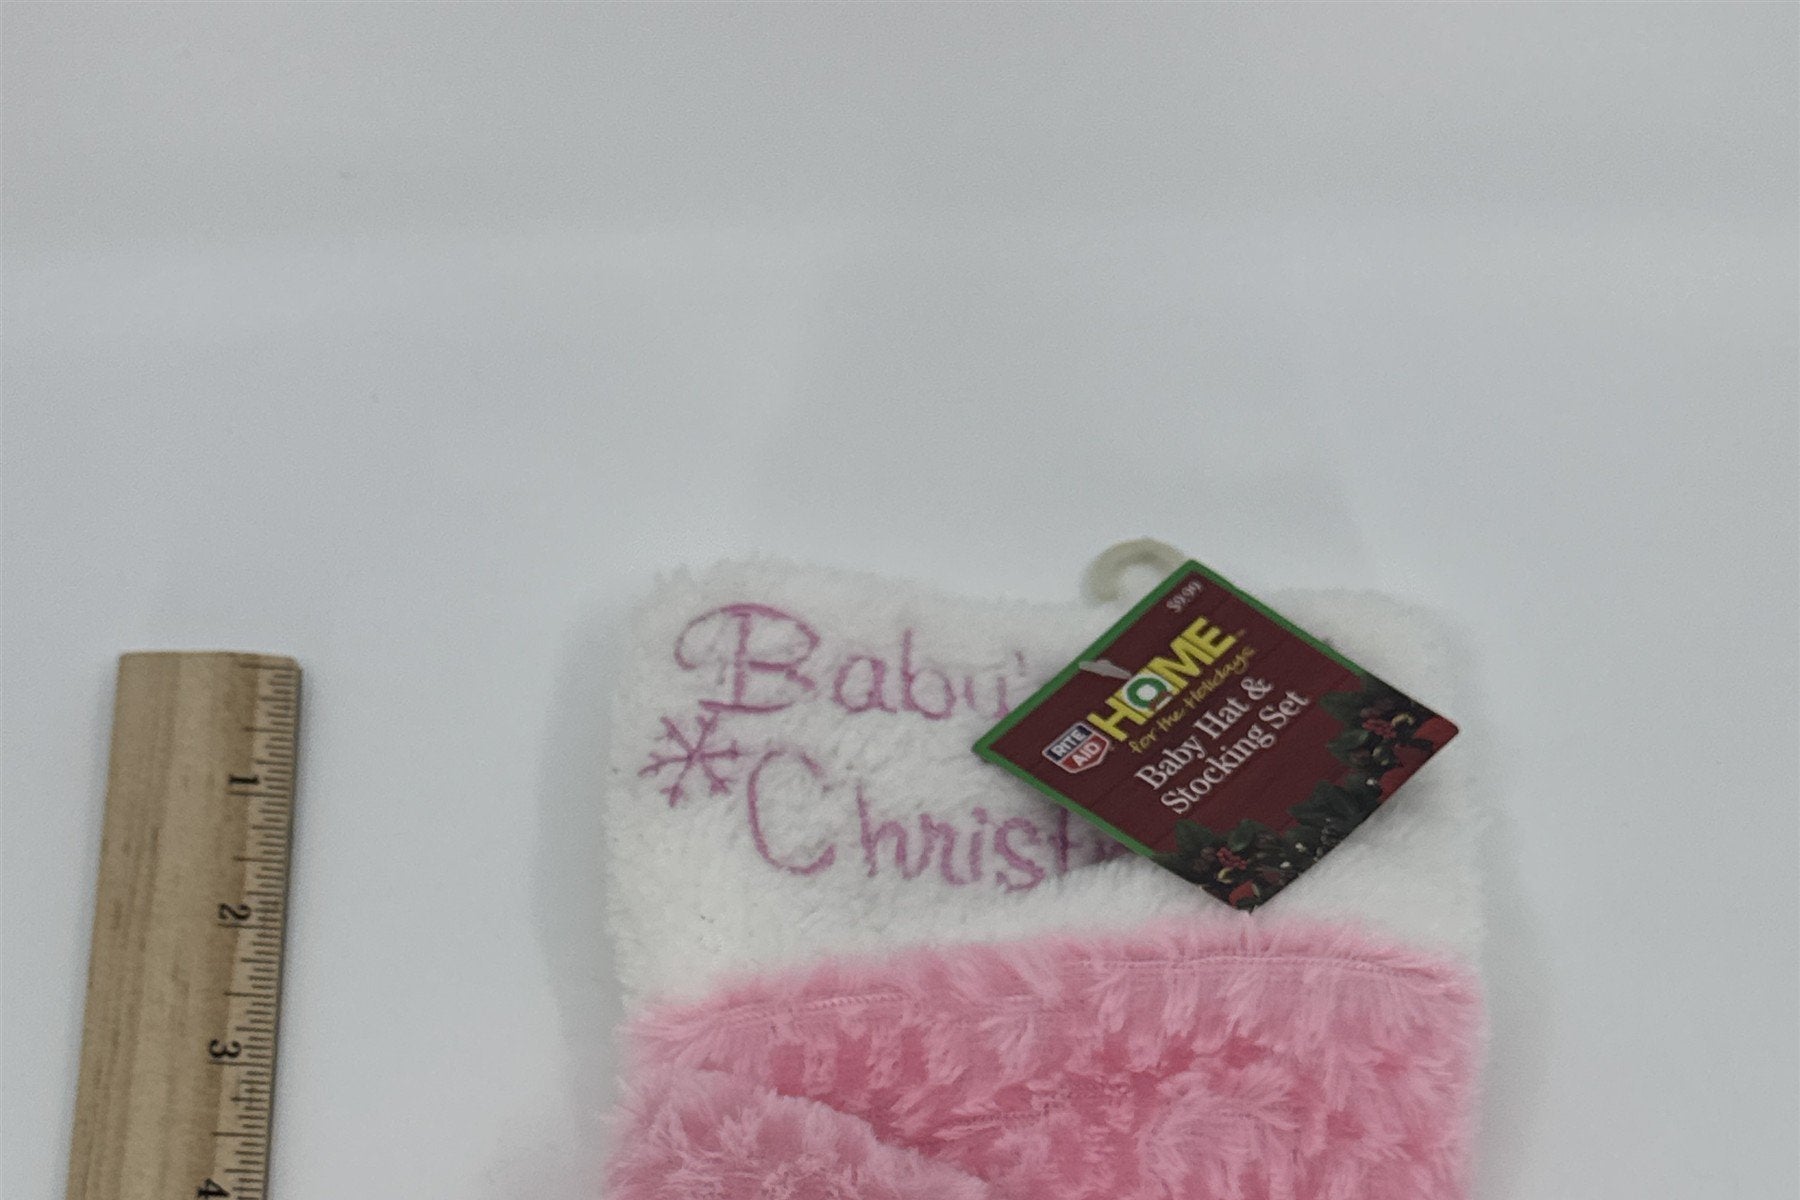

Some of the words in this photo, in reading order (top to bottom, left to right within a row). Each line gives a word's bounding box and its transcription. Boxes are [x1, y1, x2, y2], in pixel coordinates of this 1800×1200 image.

[1086, 615, 1237, 742] HOME
[1128, 728, 1157, 753] for
[1156, 706, 1186, 732] the
[1183, 646, 1255, 708] Holidays
[1050, 729, 1087, 757] RITE
[1133, 735, 1206, 790] Baby
[1193, 697, 1251, 739] Hat
[1240, 675, 1274, 700] &
[1071, 742, 1101, 767] AID
[1160, 723, 1276, 814] Stocking
[1258, 690, 1311, 730] Set
[228, 774, 260, 786] 1
[218, 902, 252, 922] 2
[208, 1038, 242, 1060] 3
[197, 1178, 231, 1199] 4
